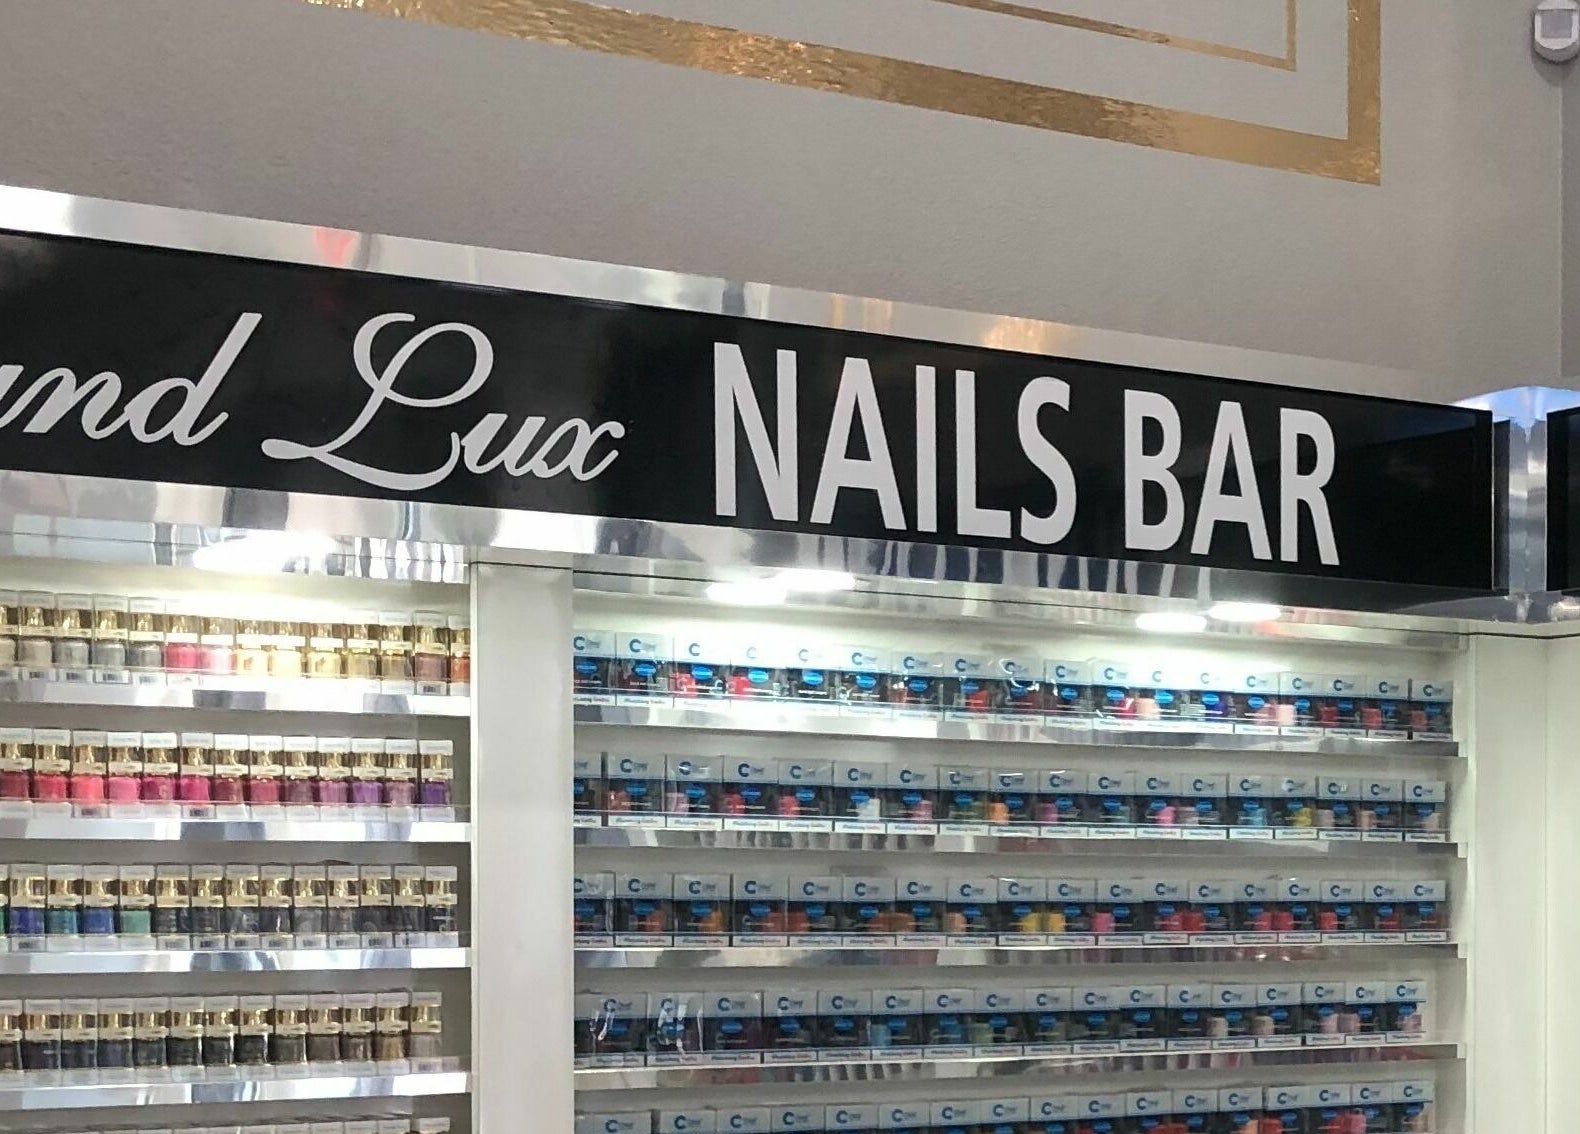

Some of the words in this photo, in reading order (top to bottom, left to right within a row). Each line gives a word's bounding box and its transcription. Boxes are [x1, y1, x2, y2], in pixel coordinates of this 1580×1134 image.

[262, 312, 626, 491] Lux
[714, 342, 1077, 545] NAILS
[1125, 390, 1340, 566] BAR
